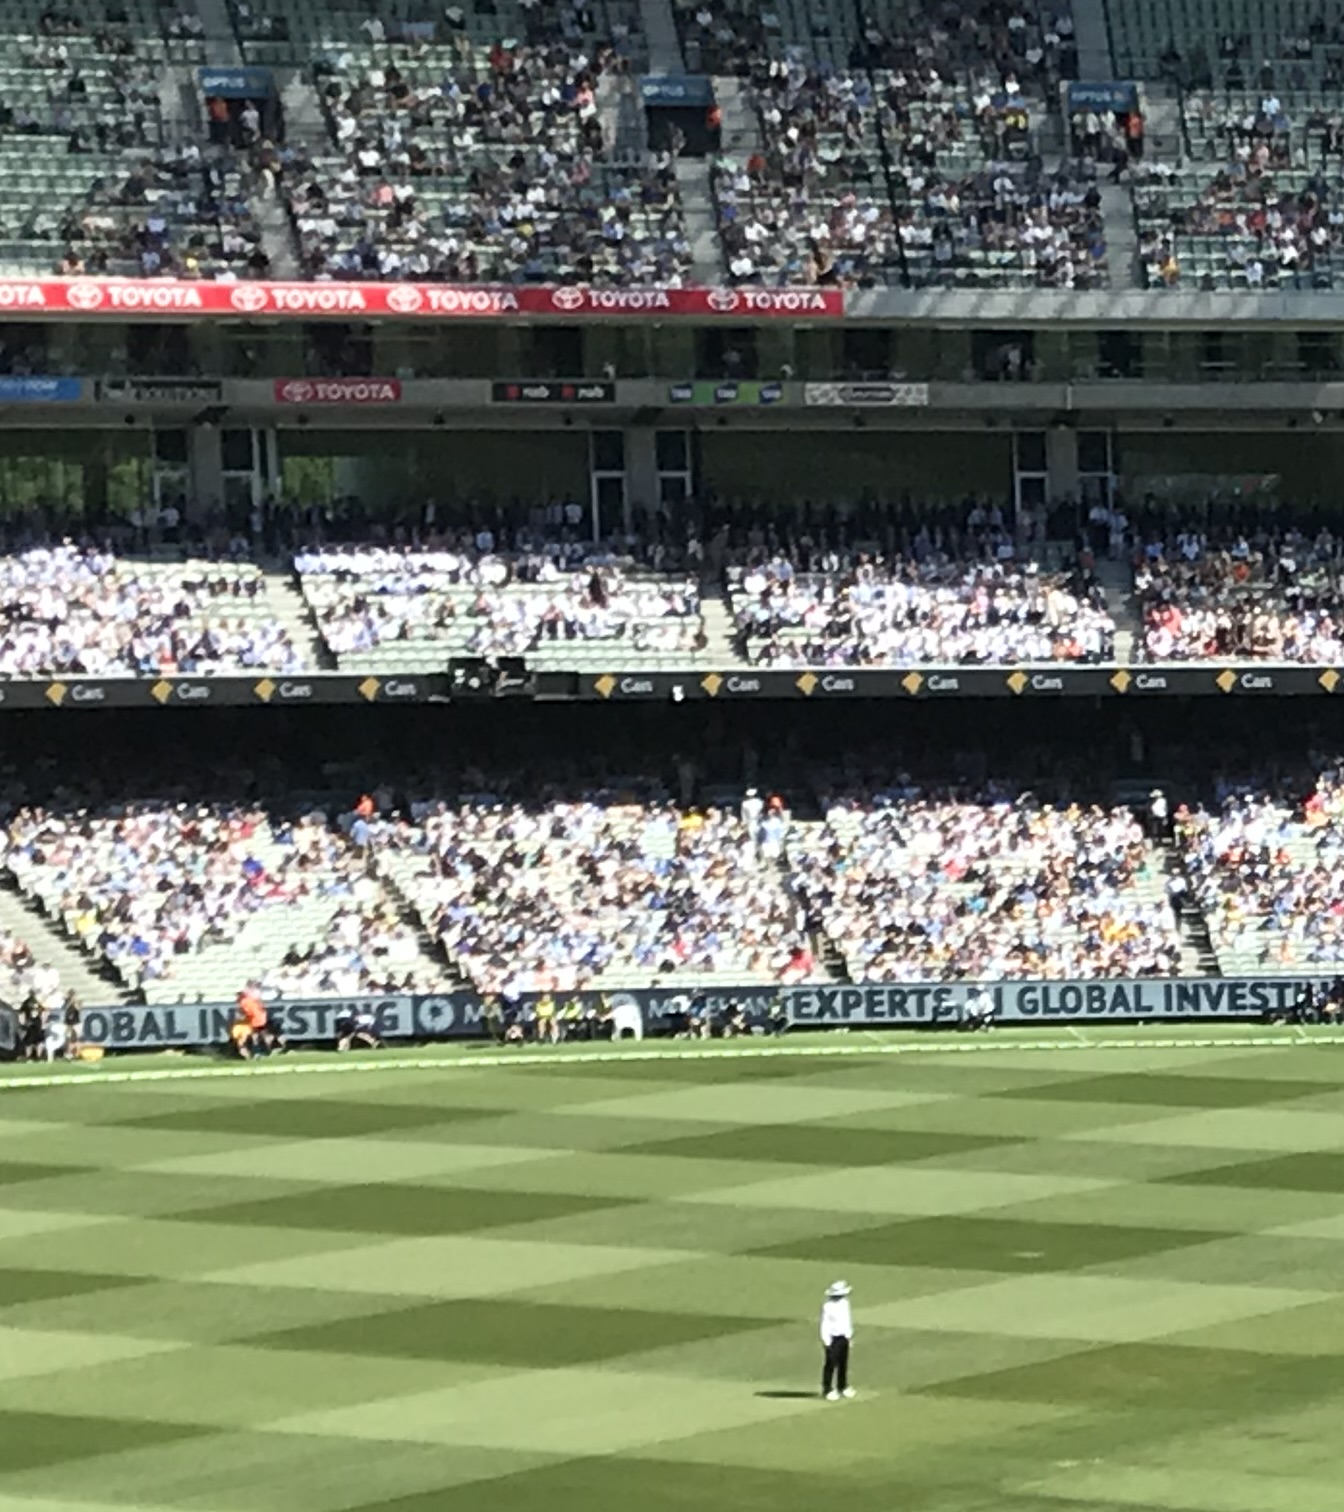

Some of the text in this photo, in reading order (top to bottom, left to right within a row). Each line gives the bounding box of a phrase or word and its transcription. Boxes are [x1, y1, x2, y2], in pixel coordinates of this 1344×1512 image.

[108, 286, 202, 307] TOYOTA
[271, 289, 366, 309] TOYOTA
[426, 291, 518, 310] TOYOTA
[590, 290, 671, 308] TOYOTA
[744, 292, 827, 310] TOYOTA
[316, 383, 394, 400] TOYOTA
[620, 676, 652, 693] Can
[727, 676, 760, 692] Can
[821, 675, 854, 691] Can
[928, 675, 959, 690] Can
[1032, 675, 1063, 690] Can
[1136, 673, 1167, 689] Can
[1241, 673, 1272, 688] Can
[1016, 984, 1153, 1015] GLOBAL
